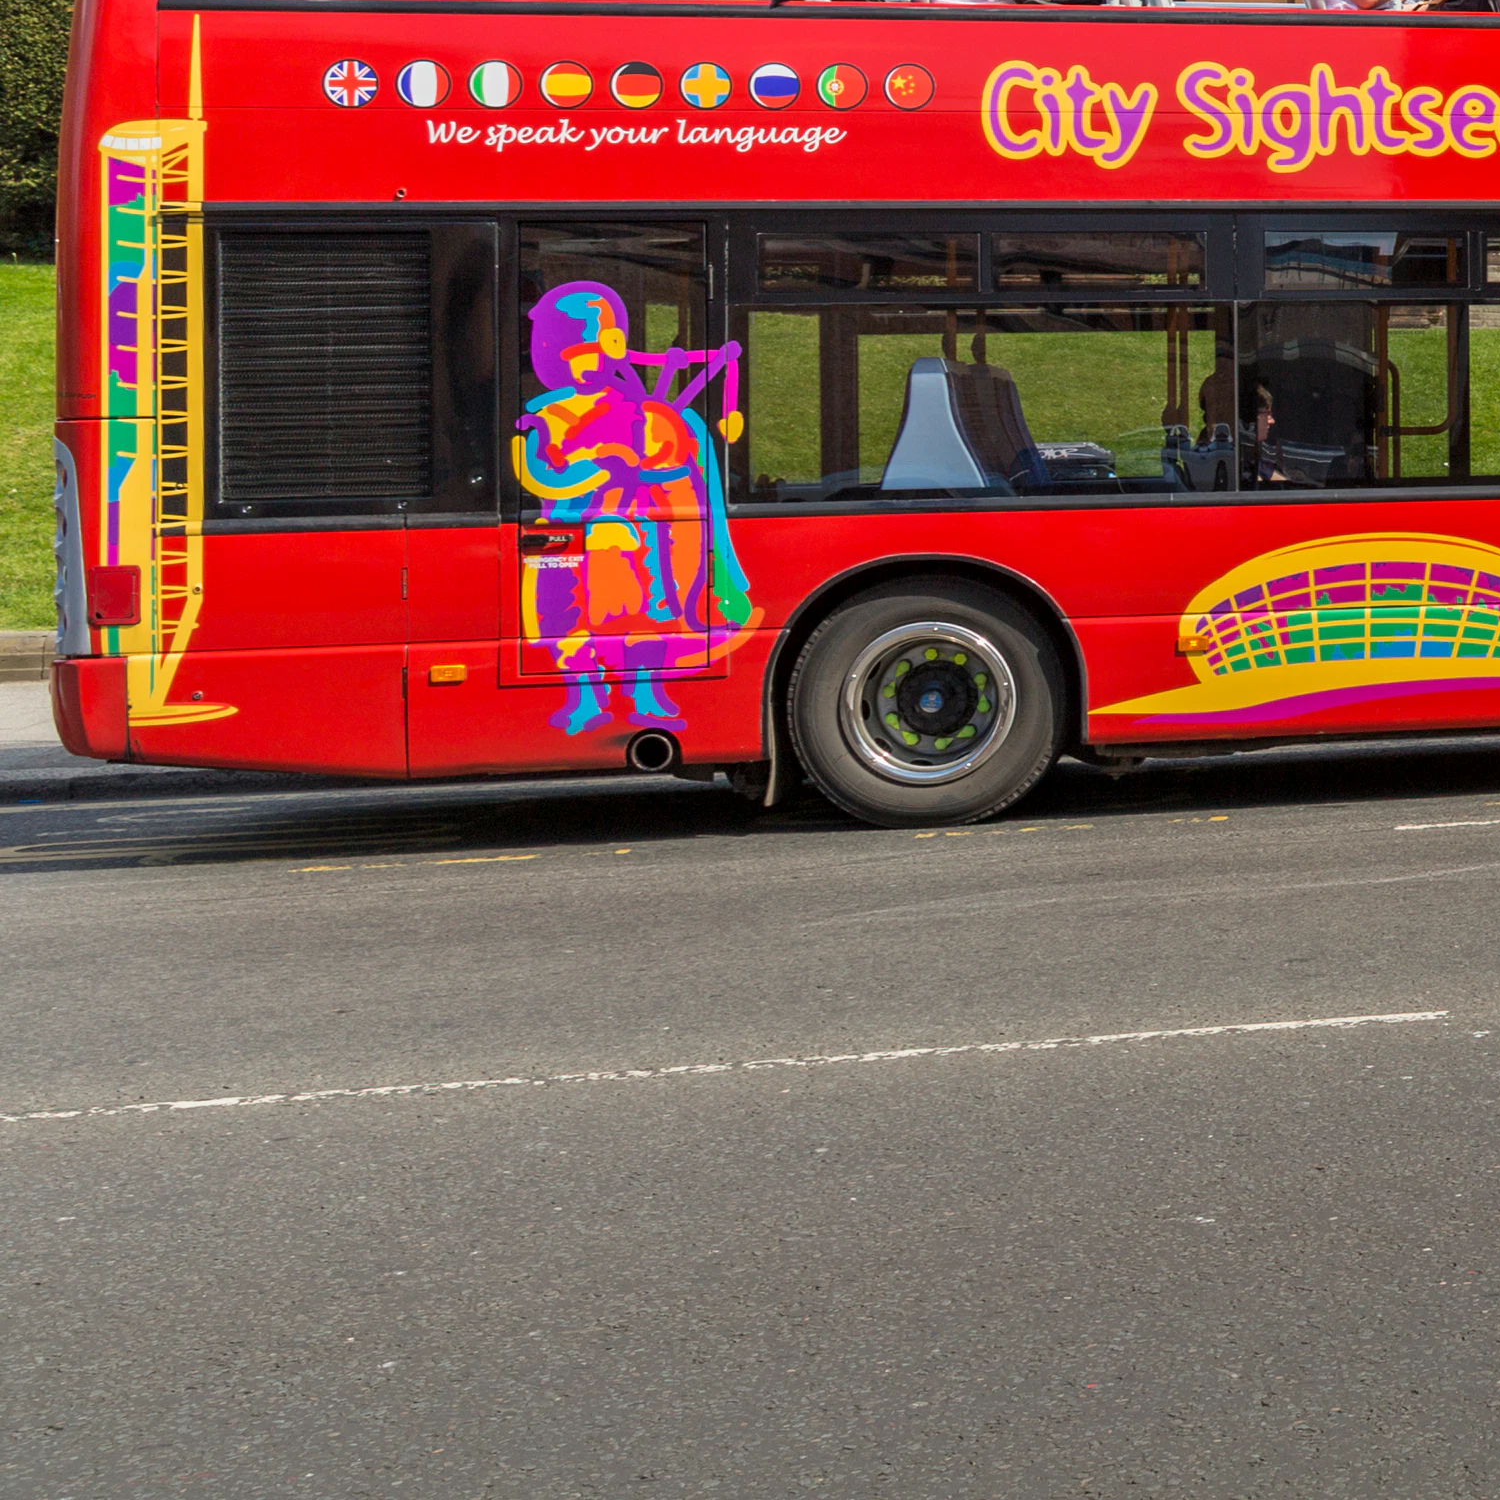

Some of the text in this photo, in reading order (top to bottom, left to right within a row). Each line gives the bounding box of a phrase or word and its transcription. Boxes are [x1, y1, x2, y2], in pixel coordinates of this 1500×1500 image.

[425, 119, 848, 153] We speak your language
[983, 60, 1156, 169] City
